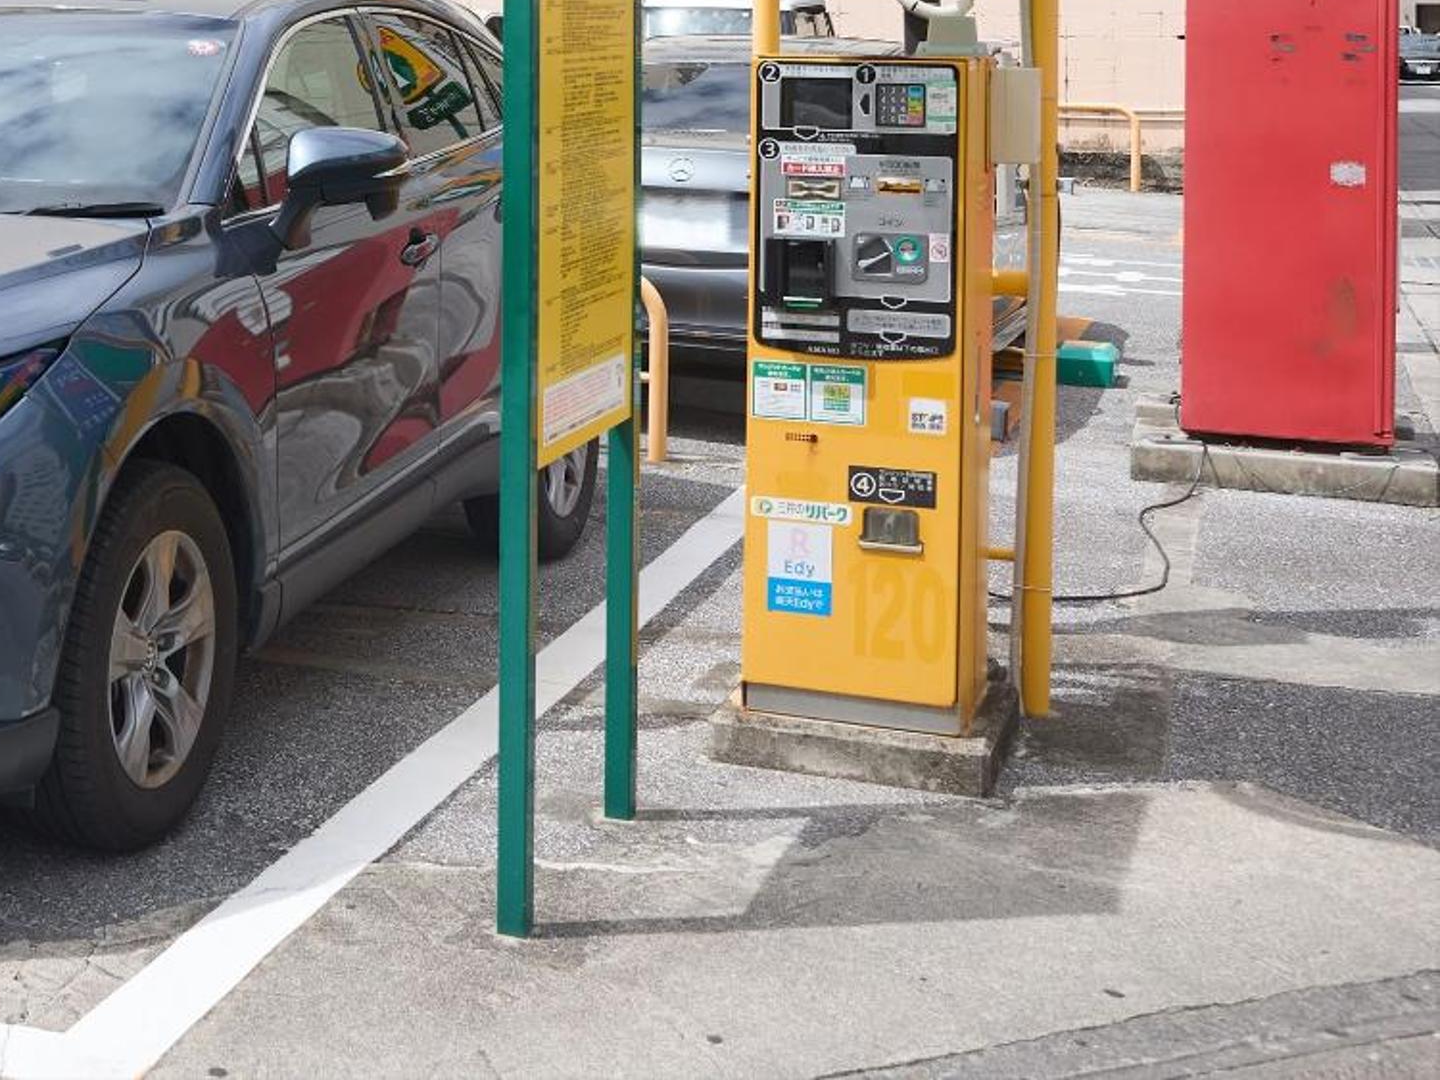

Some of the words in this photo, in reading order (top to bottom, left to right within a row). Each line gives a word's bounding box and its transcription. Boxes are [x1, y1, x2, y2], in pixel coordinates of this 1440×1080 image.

[777, 502, 848, 521] 三井のリパーク
[784, 560, 816, 577] Edy
